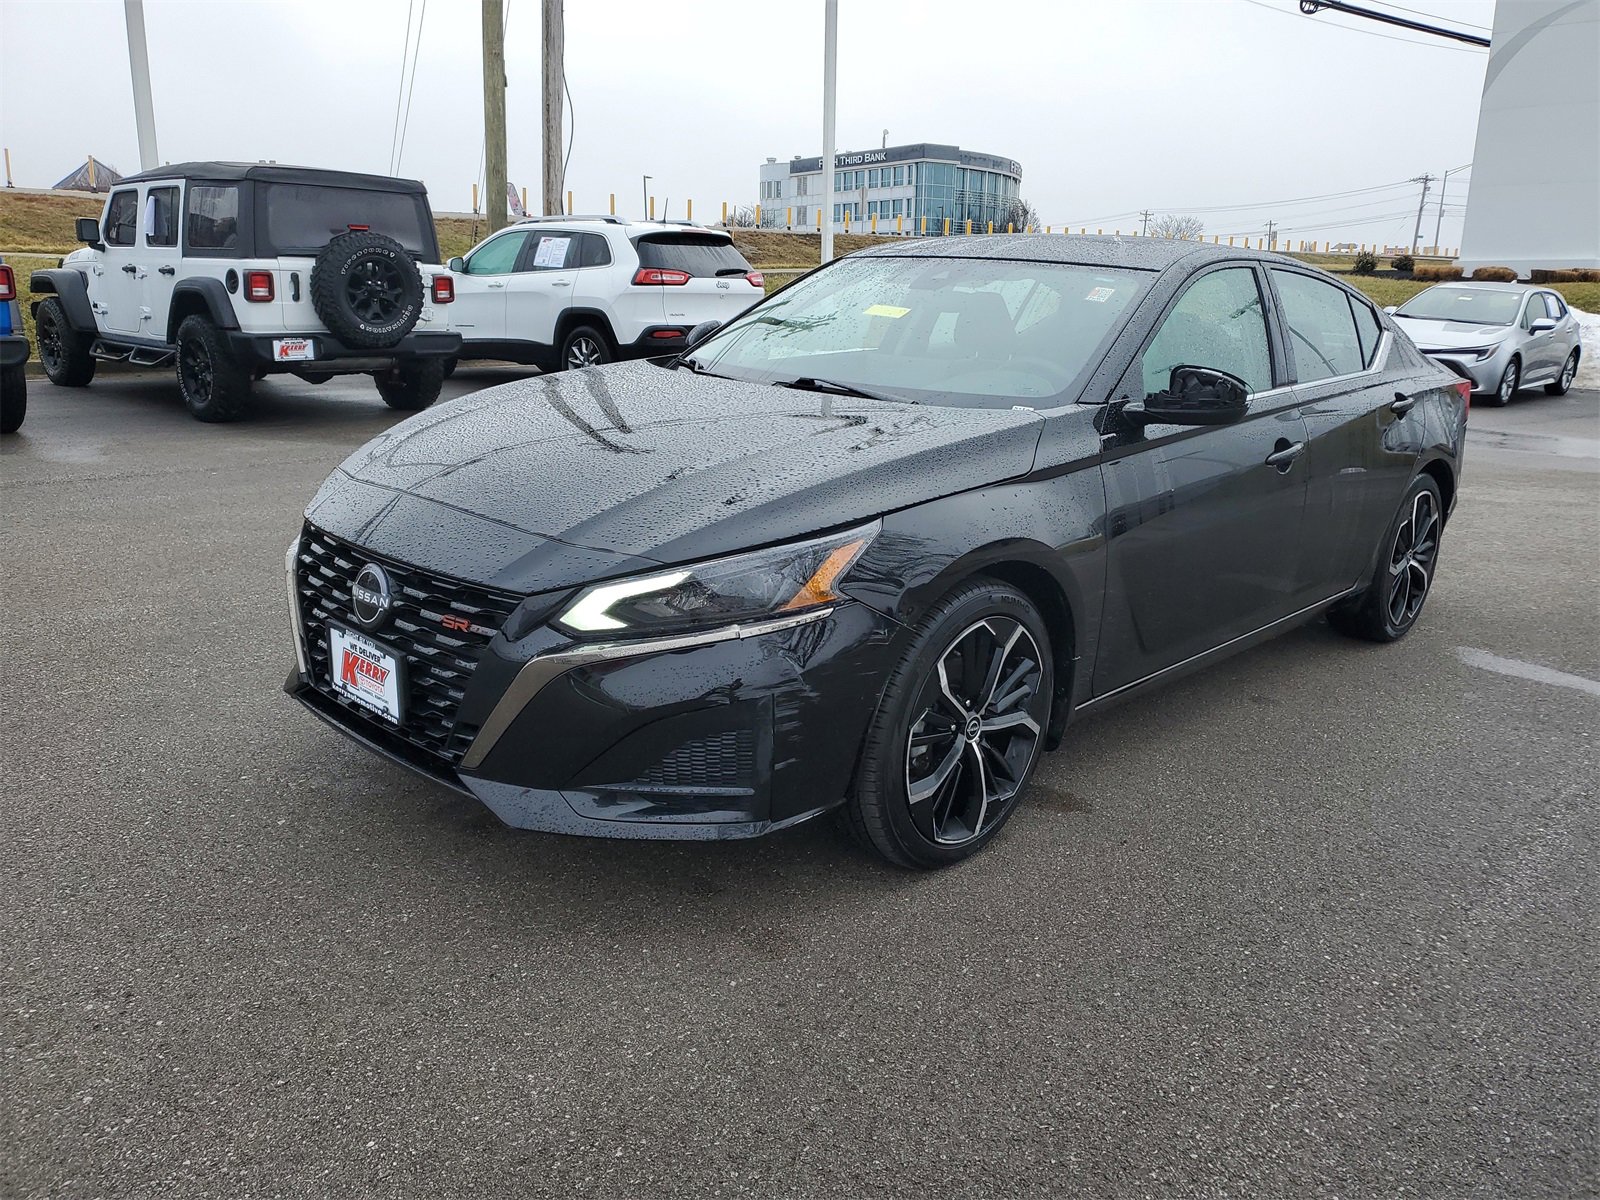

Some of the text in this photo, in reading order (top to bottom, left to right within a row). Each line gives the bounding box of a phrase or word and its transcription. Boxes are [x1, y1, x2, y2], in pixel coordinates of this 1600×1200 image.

[840, 155, 863, 166] THIRD
[864, 152, 886, 163] BANK
[716, 280, 730, 290] Jeep
[352, 581, 389, 608] NISSAN
[442, 614, 469, 633] SR
[349, 641, 381, 663] WE DELIVER
[341, 649, 389, 689] KERRY
[332, 682, 398, 724] kerryautomotive.com
